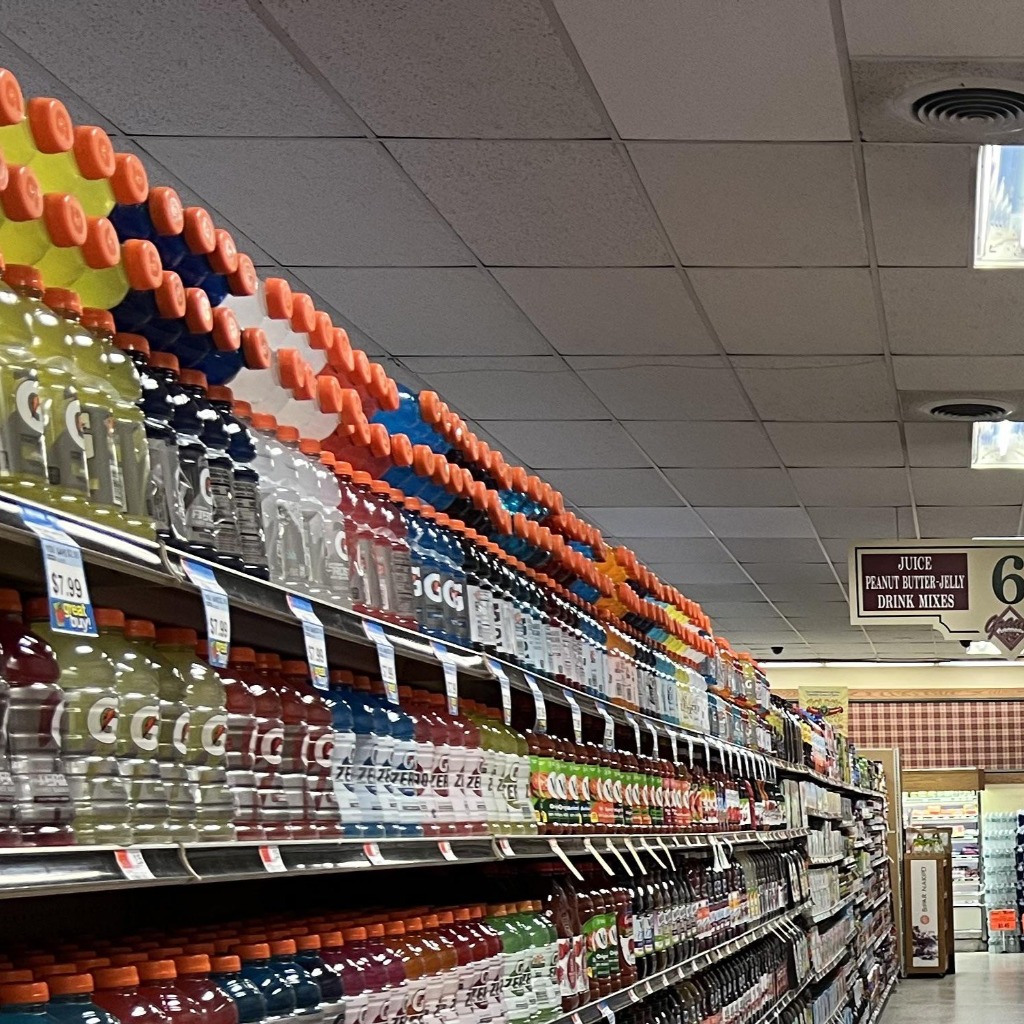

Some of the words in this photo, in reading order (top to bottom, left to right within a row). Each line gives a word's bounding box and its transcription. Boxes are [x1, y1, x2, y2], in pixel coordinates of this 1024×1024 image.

[898, 557, 932, 571] JUICE
[51, 572, 83, 599] $7.99
[422, 573, 441, 602] G
[443, 580, 465, 611] G
[865, 576, 899, 590] PEANUT
[902, 575, 965, 590] BUTTER-JELLY
[63, 602, 87, 618] great
[877, 594, 915, 609] DRINK
[919, 594, 955, 609] MIXES
[210, 618, 228, 638] $7.99
[88, 697, 118, 744] G
[130, 706, 159, 751] G
[201, 715, 227, 756] G
[261, 727, 283, 764] G
